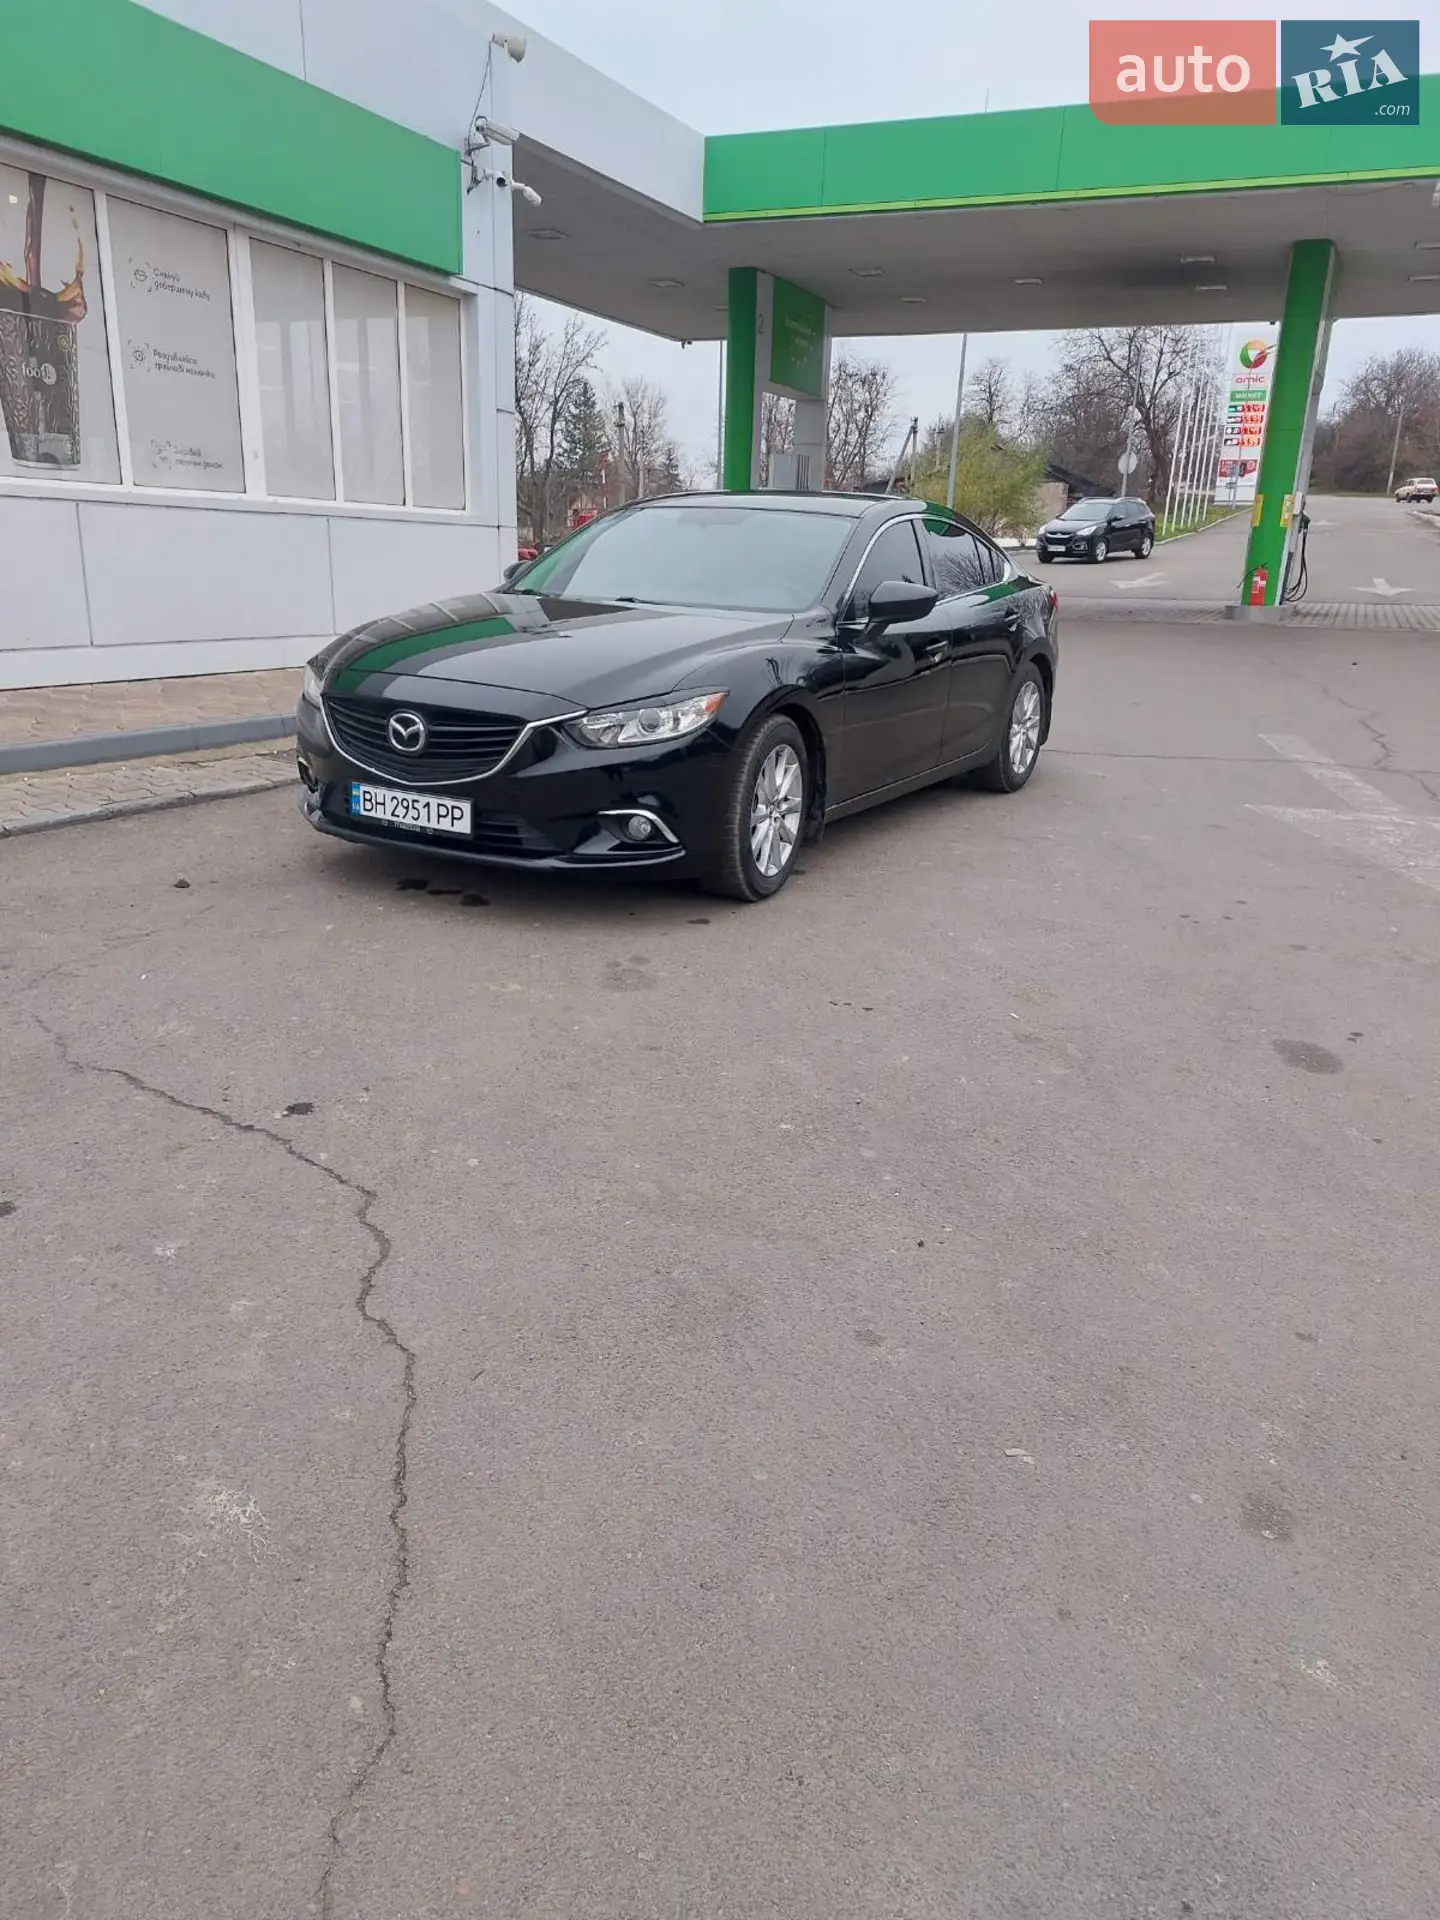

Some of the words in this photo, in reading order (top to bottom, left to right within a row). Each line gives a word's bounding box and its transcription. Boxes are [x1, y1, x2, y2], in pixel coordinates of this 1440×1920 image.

[757, 313, 766, 335] 2
[1236, 375, 1265, 384] amic
[363, 790, 386, 815] BH
[390, 796, 430, 823] 2951
[437, 803, 464, 827] PP
